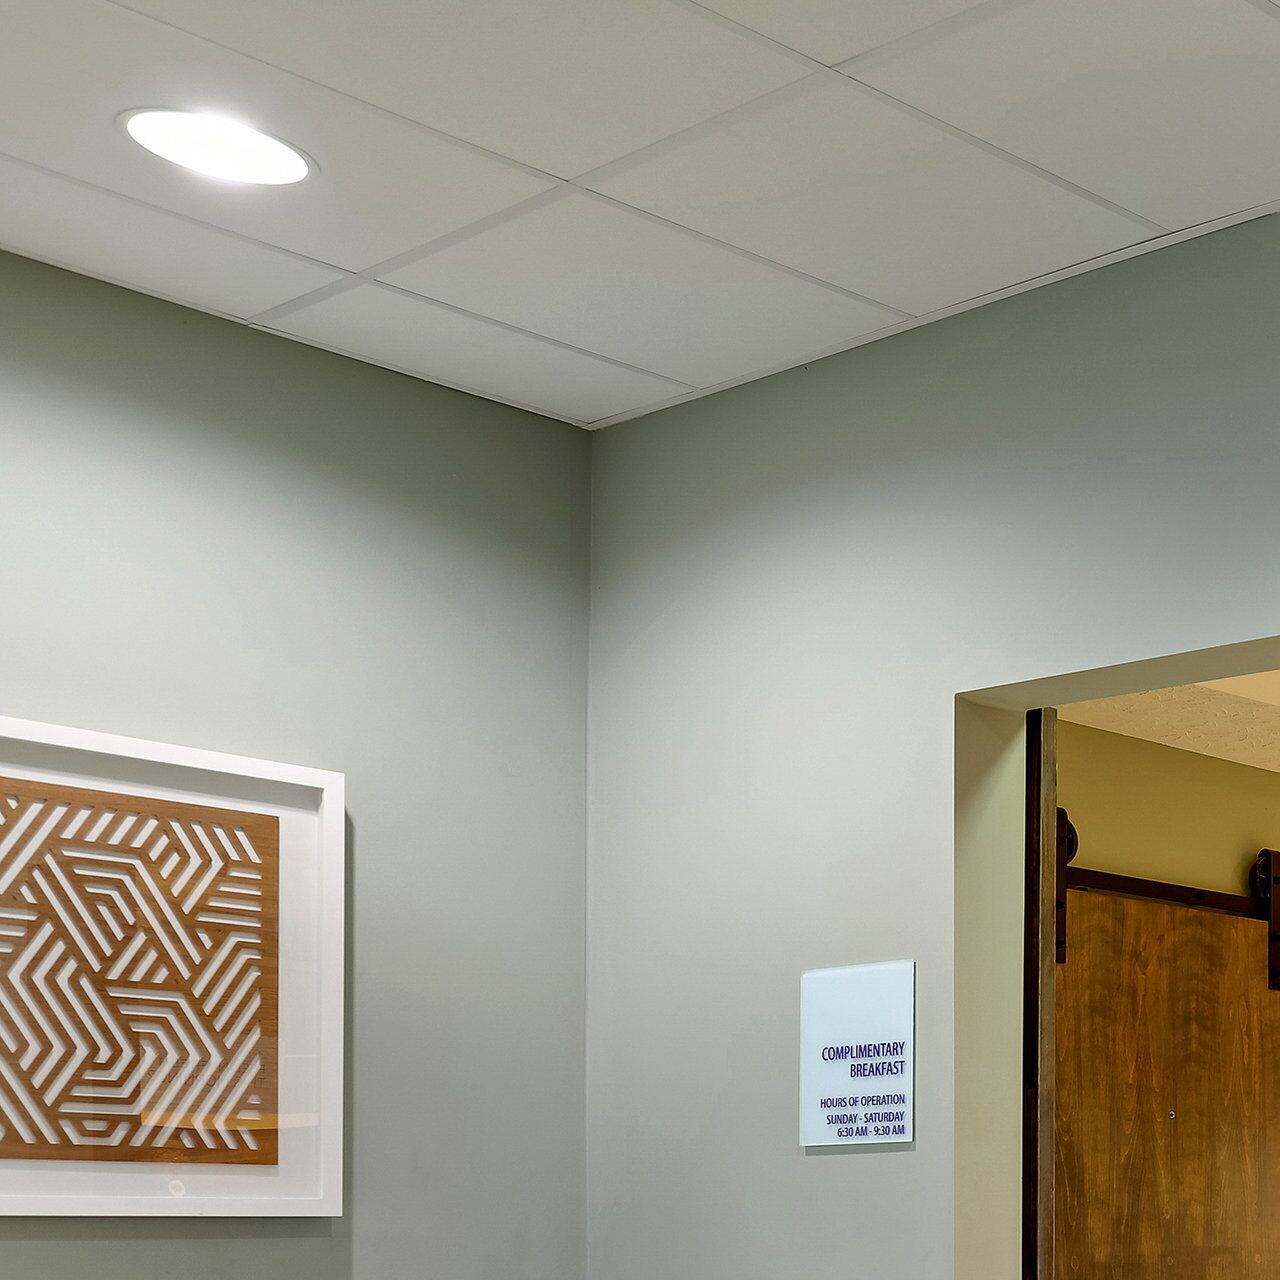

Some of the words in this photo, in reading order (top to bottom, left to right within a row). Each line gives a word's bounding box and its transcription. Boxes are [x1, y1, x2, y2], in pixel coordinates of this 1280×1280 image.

[821, 1041, 906, 1061] COMPLIMENTARY
[850, 1060, 906, 1078] BREAKFAST
[820, 1096, 848, 1109] HOURS
[848, 1096, 860, 1107] OF
[860, 1094, 905, 1107] OPERATION
[826, 1113, 859, 1125] SUNDAY
[863, 1111, 905, 1123] SATURDAY
[837, 1127, 854, 1137] 6:30
[854, 1126, 868, 1136] AM
[873, 1125, 891, 1136] 9:30
[891, 1125, 905, 1135] AM
